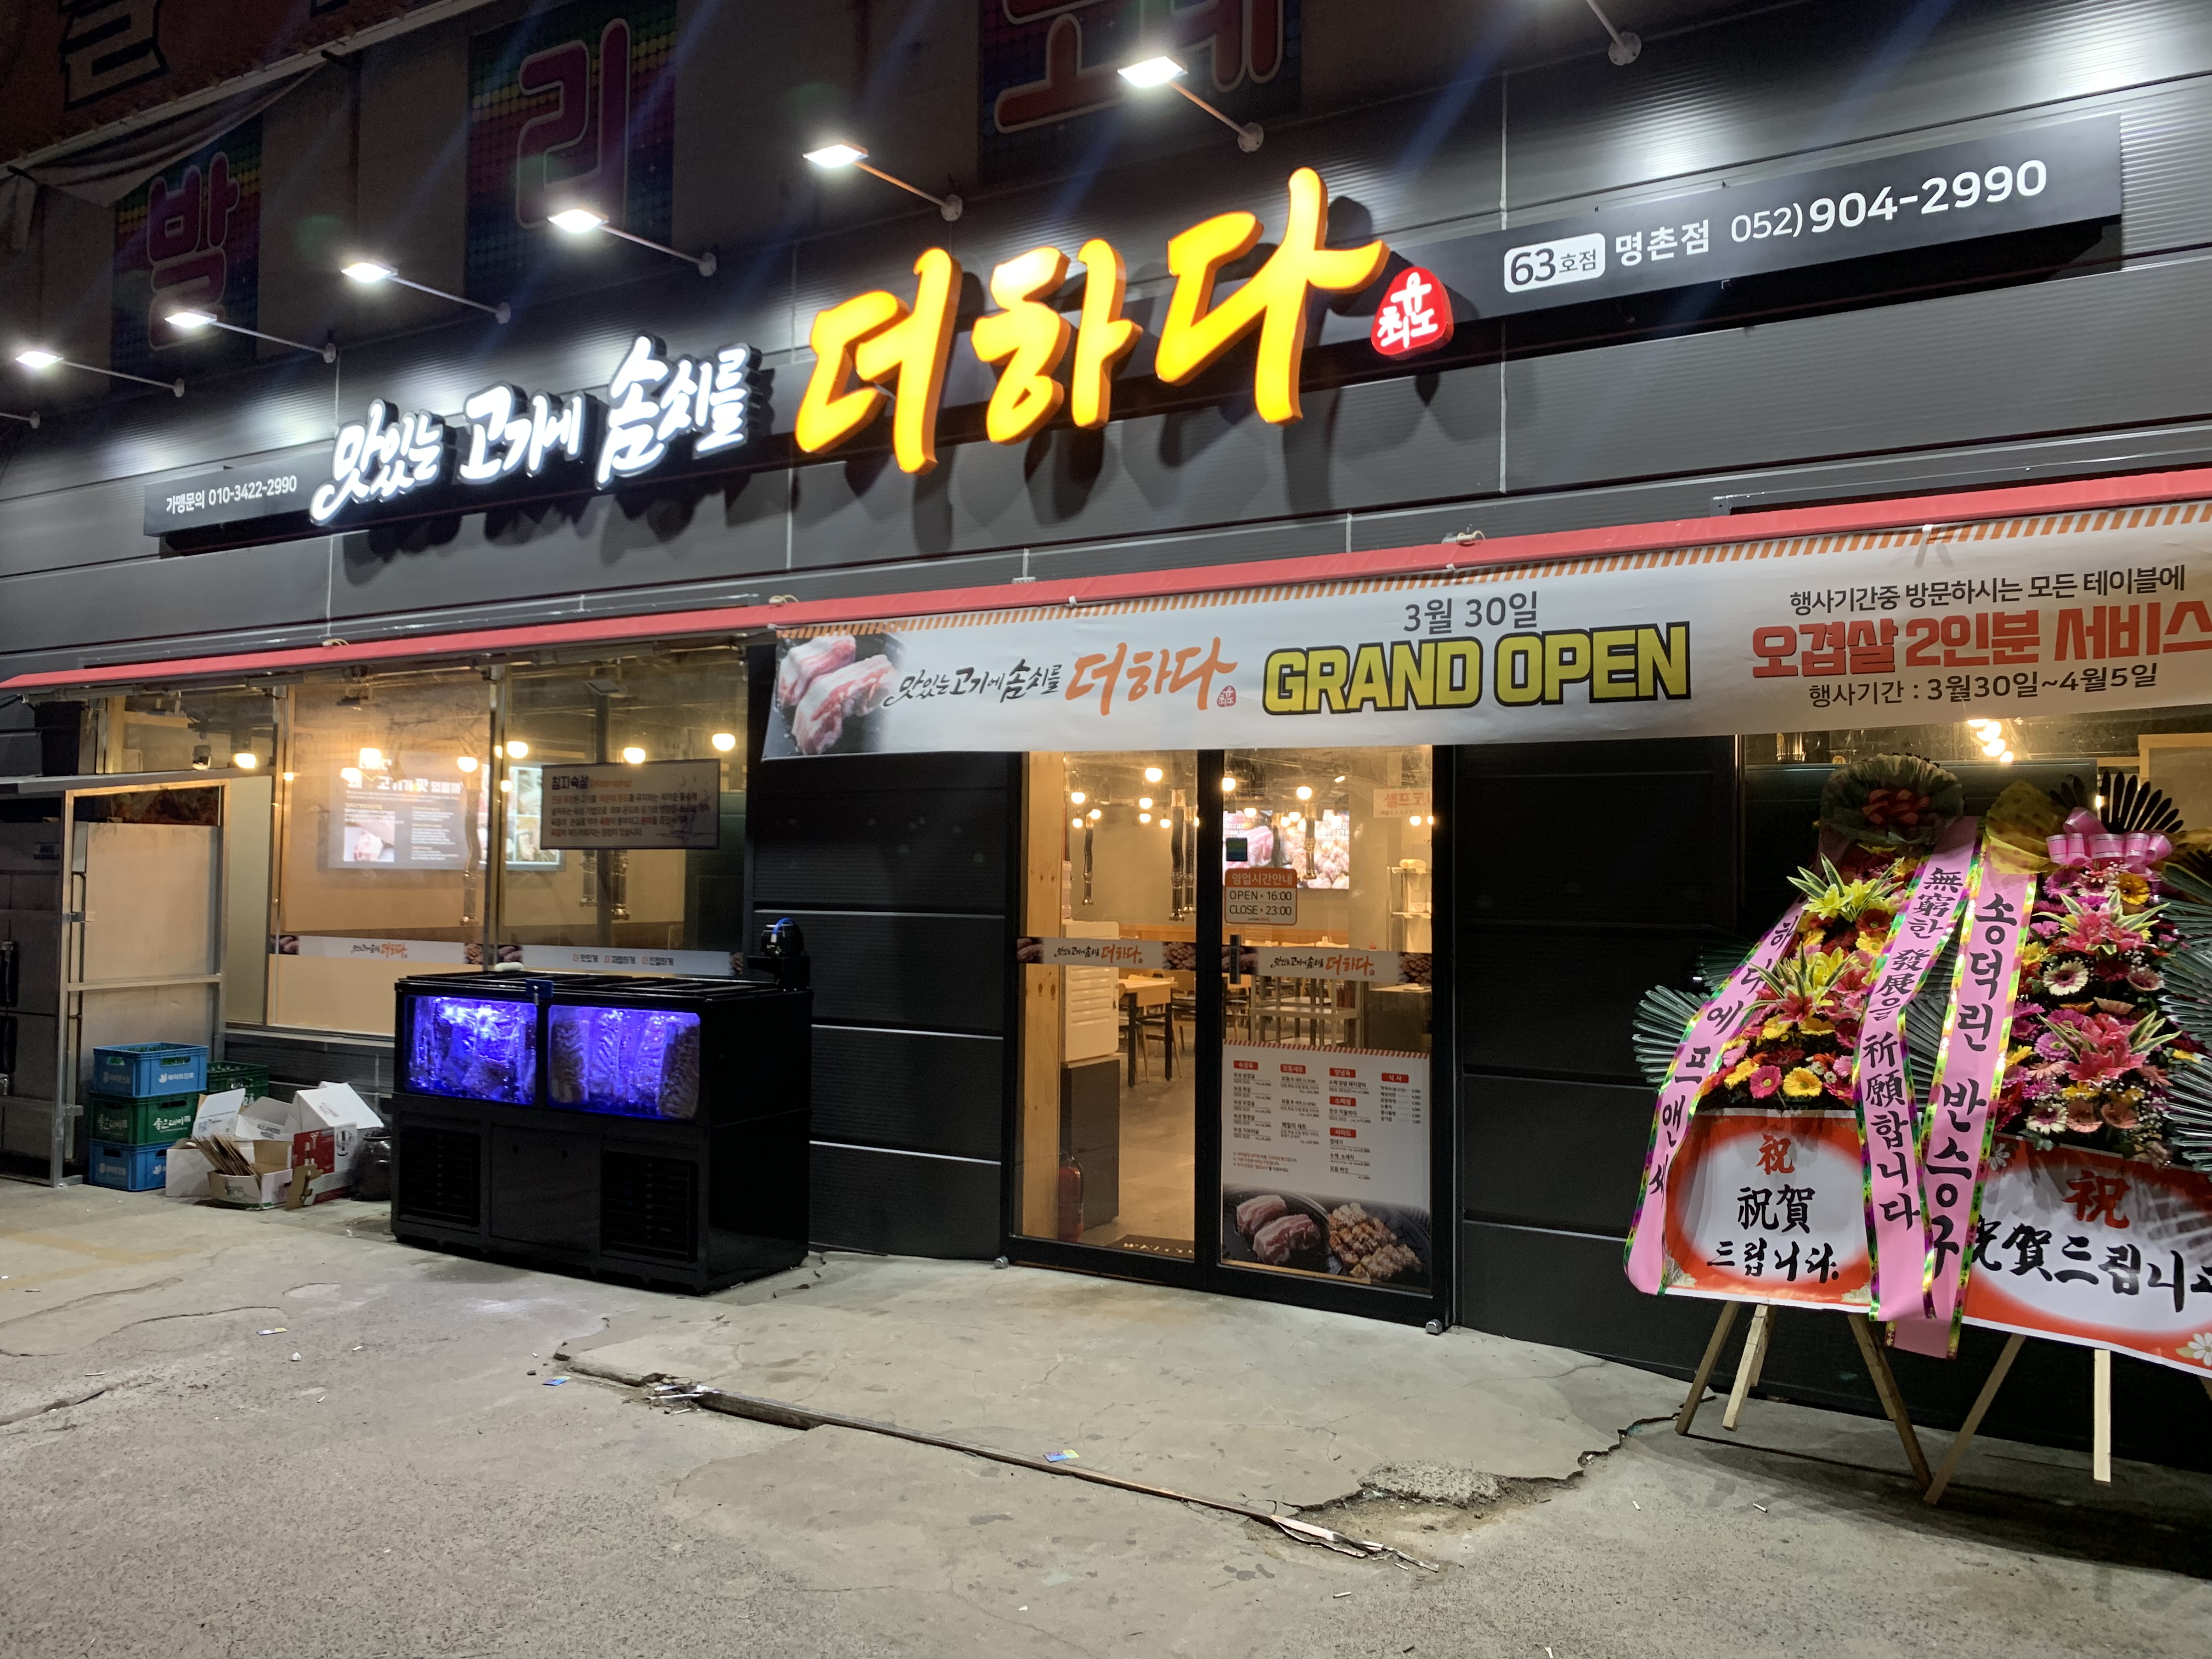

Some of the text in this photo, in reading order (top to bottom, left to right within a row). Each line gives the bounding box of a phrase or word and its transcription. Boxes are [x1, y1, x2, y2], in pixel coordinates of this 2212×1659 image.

[1510, 247, 1599, 288] 63호점
[1614, 218, 1711, 268] 명촌점
[311, 166, 1390, 522] 맛있는 고기에 솜씨를 더하다
[165, 474, 298, 518] 가맹문의 010-3422-2990
[1402, 590, 1538, 635] 3월 30일
[1790, 565, 2186, 616] 행사기간중 방문하시는 모든 테이블에
[1752, 600, 2212, 678] 오겹살 2인분 서비스
[882, 636, 1237, 715] 맛있는 고기에 솜씨를 더하다
[1263, 620, 1691, 715] GRAND OPEN
[1809, 680, 1904, 708] 행사기간
[1927, 662, 2158, 702] 3월30일~4월5일
[1229, 890, 1292, 901] OPEN 16:00
[1231, 872, 1293, 887] 영업시간안내
[1229, 905, 1292, 916] CLOSE 23:00
[1101, 944, 1143, 964] 더하다
[1325, 954, 1374, 977] 더하다
[1957, 893, 2018, 1053] 송덕린
[1755, 1134, 1795, 1175] 祝
[1737, 1184, 1816, 1234] 祝賀
[2062, 1170, 2132, 1229] 祝
